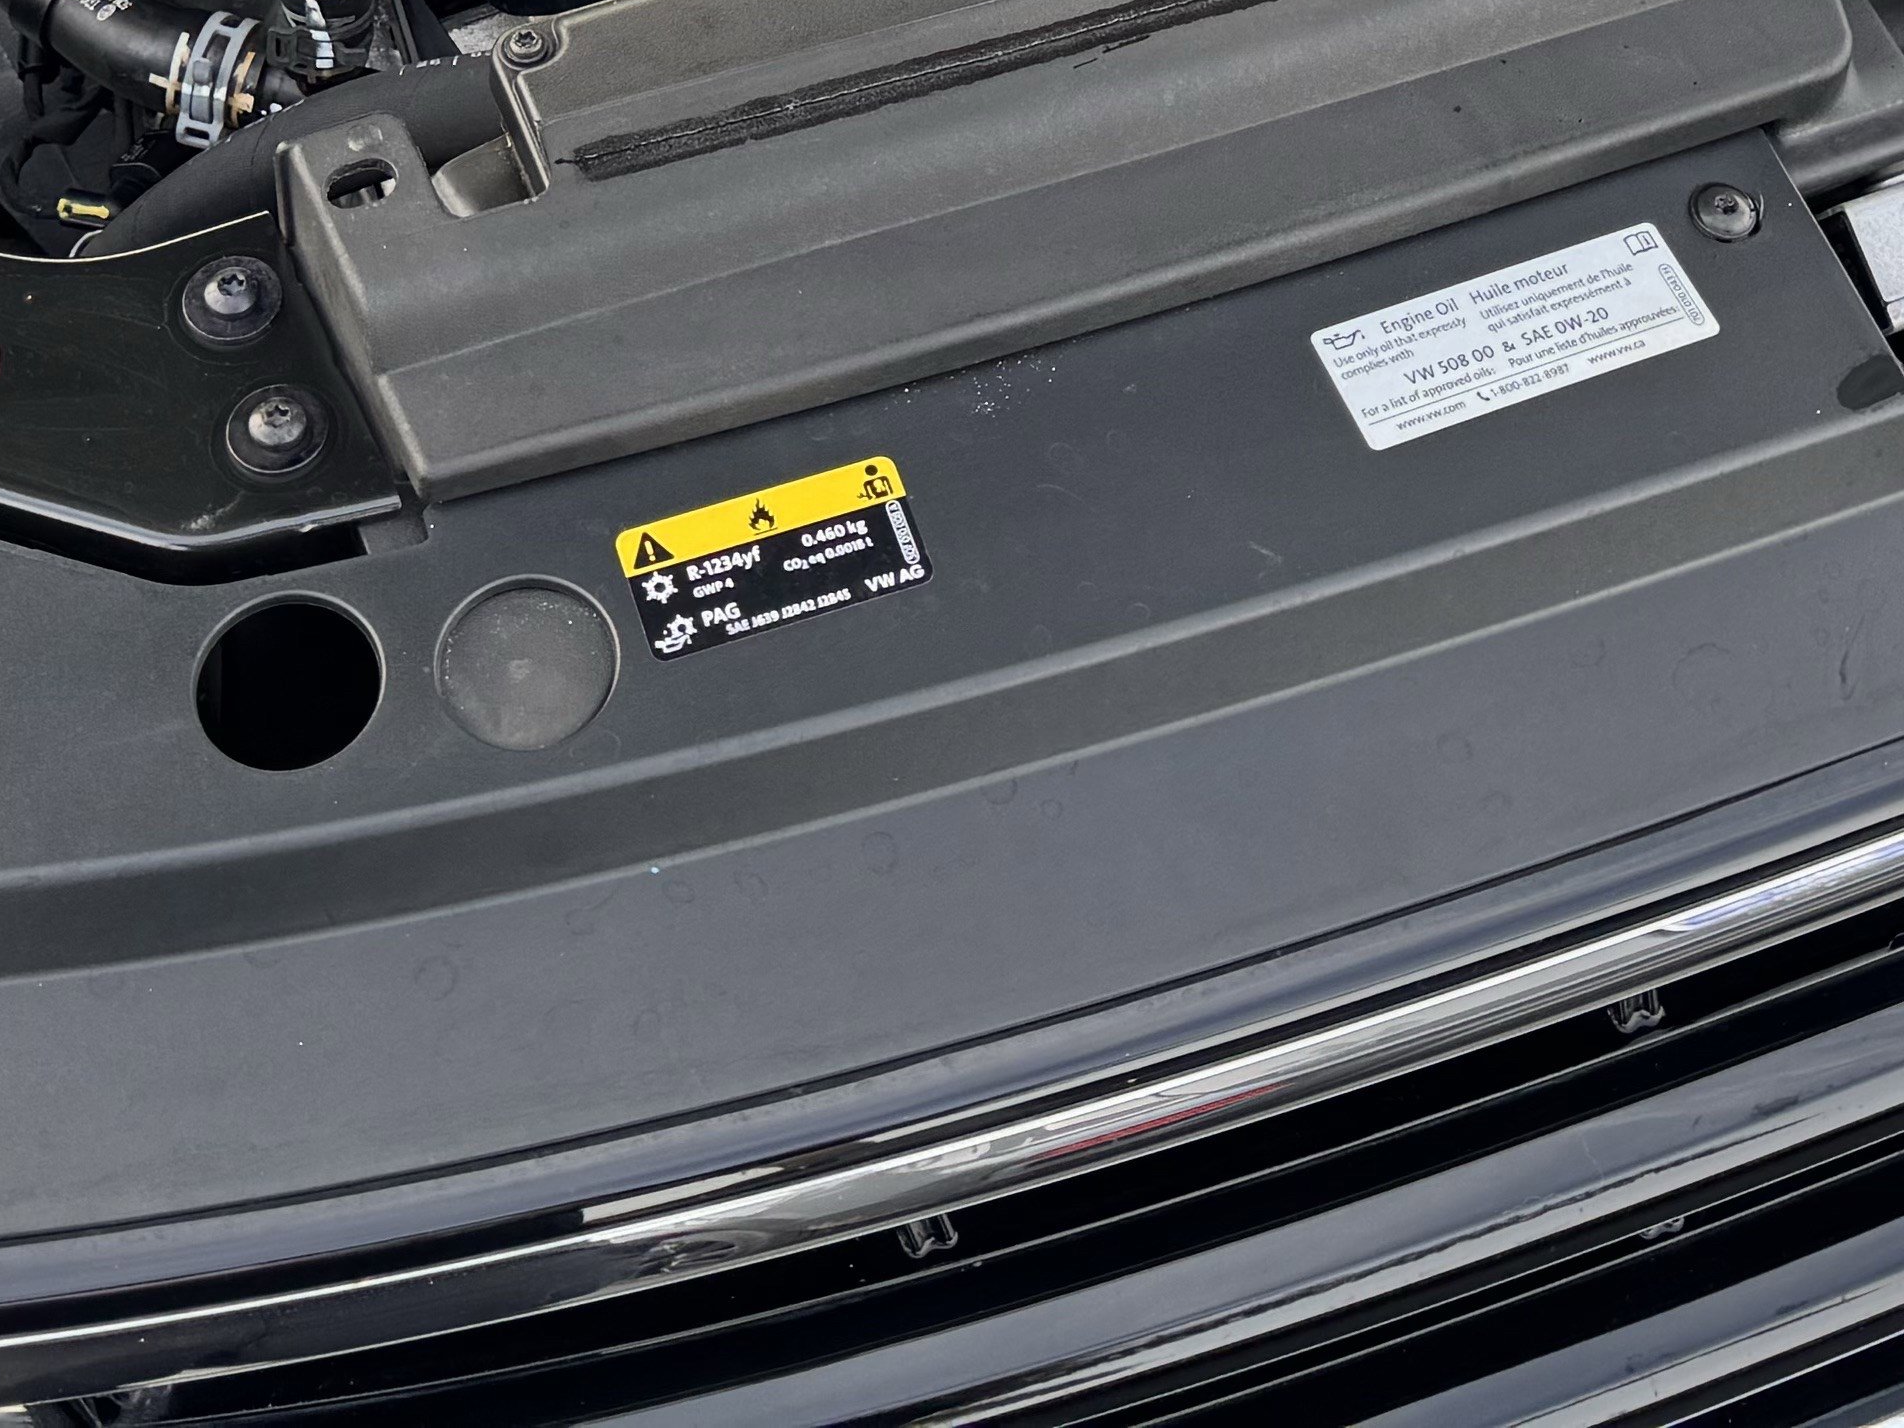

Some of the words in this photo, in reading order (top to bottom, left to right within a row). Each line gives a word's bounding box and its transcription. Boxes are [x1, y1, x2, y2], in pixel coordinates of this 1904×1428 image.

[1379, 309, 1434, 334] Engine
[1434, 296, 1459, 316] Oil
[1468, 282, 1512, 305] Huile
[1513, 263, 1568, 290] moteur
[1478, 300, 1520, 320] Utilisez
[1520, 277, 1586, 306] uniquement
[1585, 273, 1601, 285] de
[1598, 262, 1634, 279] l'huile
[1486, 317, 1507, 333] qui
[1505, 303, 1550, 325] satisfait
[1549, 279, 1623, 311] expressément
[1622, 275, 1632, 287] à
[1331, 354, 1355, 368] Use
[1354, 345, 1379, 361] only
[1378, 339, 1394, 353] oil
[1392, 332, 1418, 347] that
[1417, 316, 1466, 339] expressly
[1340, 358, 1389, 380] complies
[1387, 347, 1415, 363] with
[1402, 363, 1435, 384] VW
[1436, 353, 1470, 374] 508
[1470, 344, 1495, 363] 00
[1500, 340, 1516, 353] &
[1519, 324, 1553, 346] SAE
[1553, 306, 1609, 334] 0W-20
[1506, 352, 1533, 368] Pour
[1533, 345, 1556, 359] une
[1553, 338, 1578, 352] liste
[1577, 324, 1618, 344] d'huiles
[1618, 305, 1679, 331] approuvées:
[1360, 405, 1380, 418] For
[1380, 402, 1390, 412] a
[1387, 395, 1408, 409] list
[1407, 388, 1421, 403] of
[1421, 371, 1472, 398] approved
[1472, 366, 1496, 380] oils:
[1395, 400, 1466, 430] www.vw.com
[1489, 362, 1569, 397] 1-800-822-8987
[1586, 339, 1646, 364] www.vw.ca
[685, 544, 760, 581] R-1234yf
[800, 523, 846, 547] 0.460
[844, 519, 868, 535] kg
[863, 570, 895, 592] VW
[898, 563, 925, 583] AG
[691, 579, 724, 598] GWP
[700, 601, 741, 627] PAG
[724, 617, 751, 635] SAE
